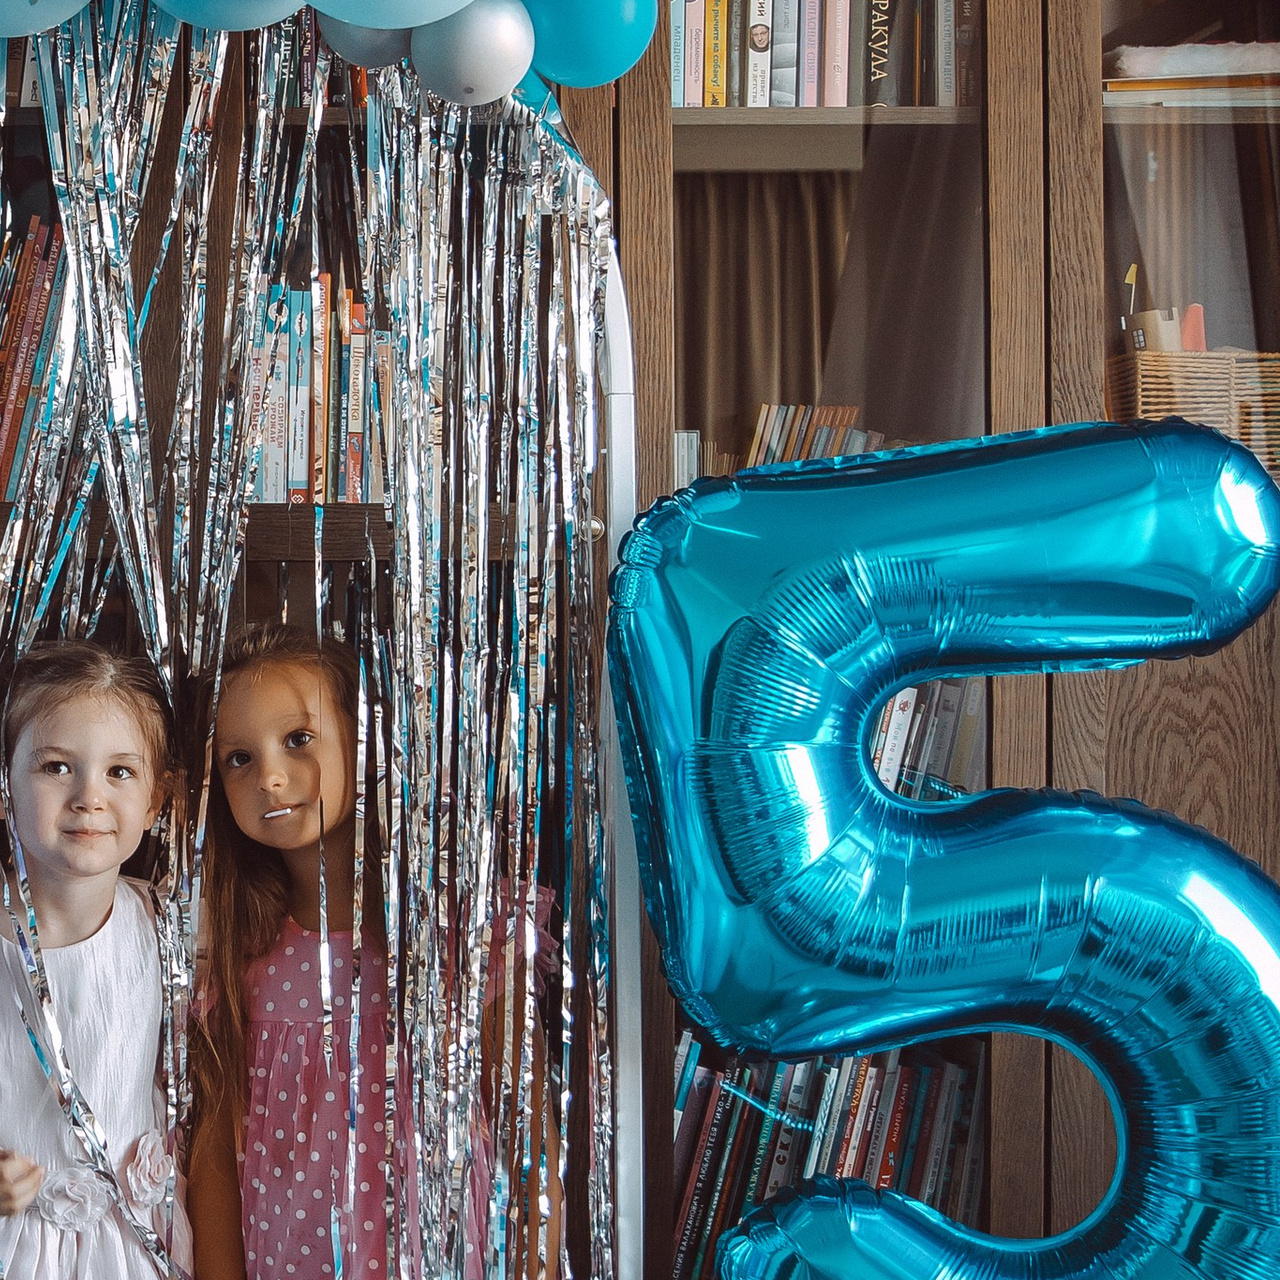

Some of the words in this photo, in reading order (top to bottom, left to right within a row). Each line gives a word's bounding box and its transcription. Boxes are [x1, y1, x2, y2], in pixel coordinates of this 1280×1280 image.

[710, 8, 720, 41] рычите
[805, 0, 816, 50] ОПАСНЫЕ
[804, 51, 815, 84] СВЯЗИ
[20, 341, 38, 387] ПОВЕСТЬ
[32, 280, 51, 331] КРОЛИК
[350, 345, 364, 421] Щекоталочка
[268, 400, 277, 443] УРОЖАЙ
[276, 394, 285, 449] СОБИРАЕМ
[339, 417, 347, 451] SAUVETAGE
[705, 1125, 718, 1147] ТЕБЯ
[772, 1082, 806, 1166] СКАКИ
[888, 1110, 903, 1143] АНДРЕЙ
[697, 1147, 714, 1180] ЛЮБЛЮ
[743, 1165, 761, 1202] СКАЗКА
